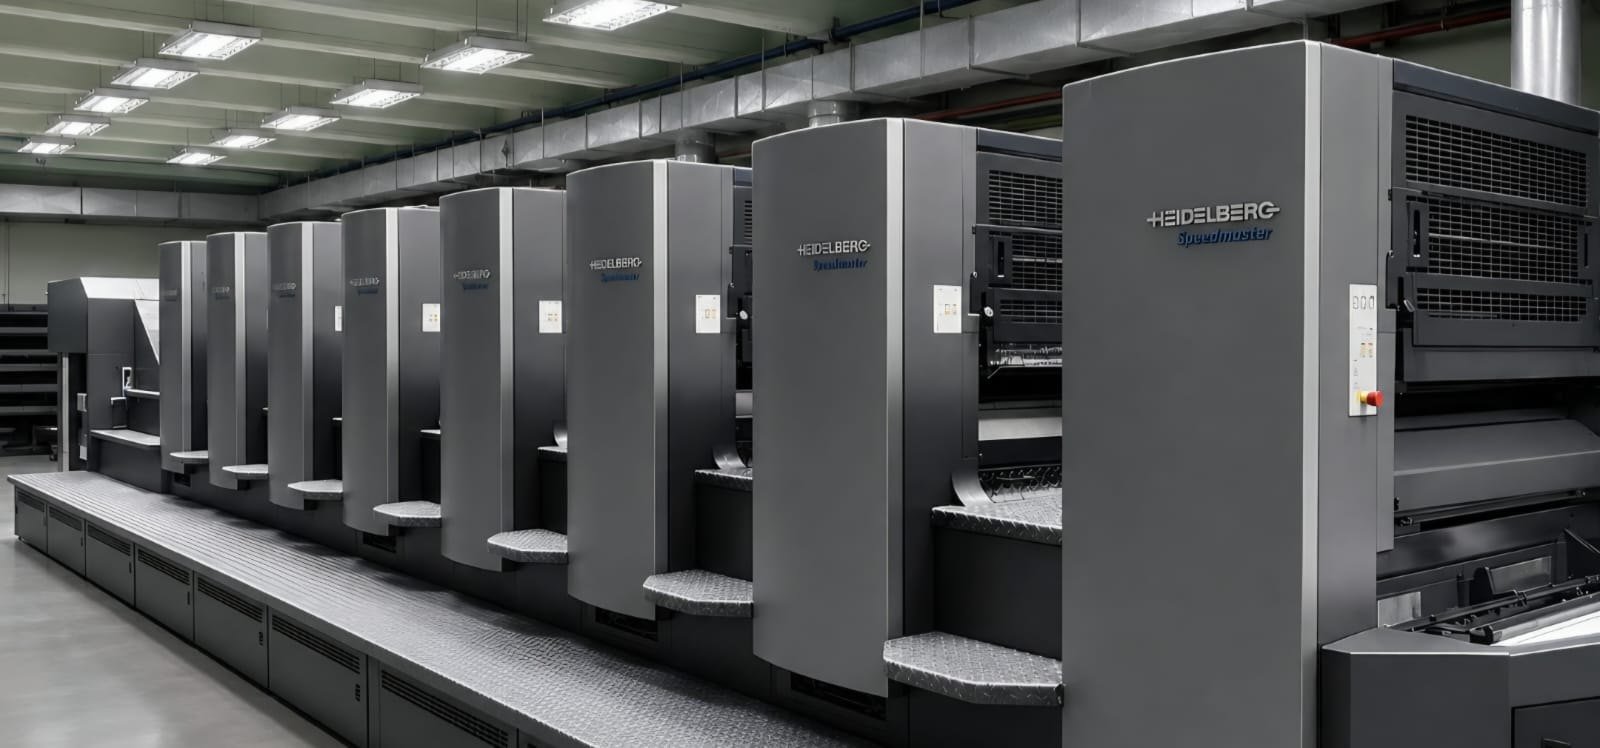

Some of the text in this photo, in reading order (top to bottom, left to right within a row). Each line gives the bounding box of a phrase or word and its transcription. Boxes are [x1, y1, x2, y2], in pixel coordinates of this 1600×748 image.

[1147, 201, 1280, 228] HEIDELBERG
[797, 239, 871, 256] HEIDELBERG
[1177, 227, 1273, 248] Speedmaster
